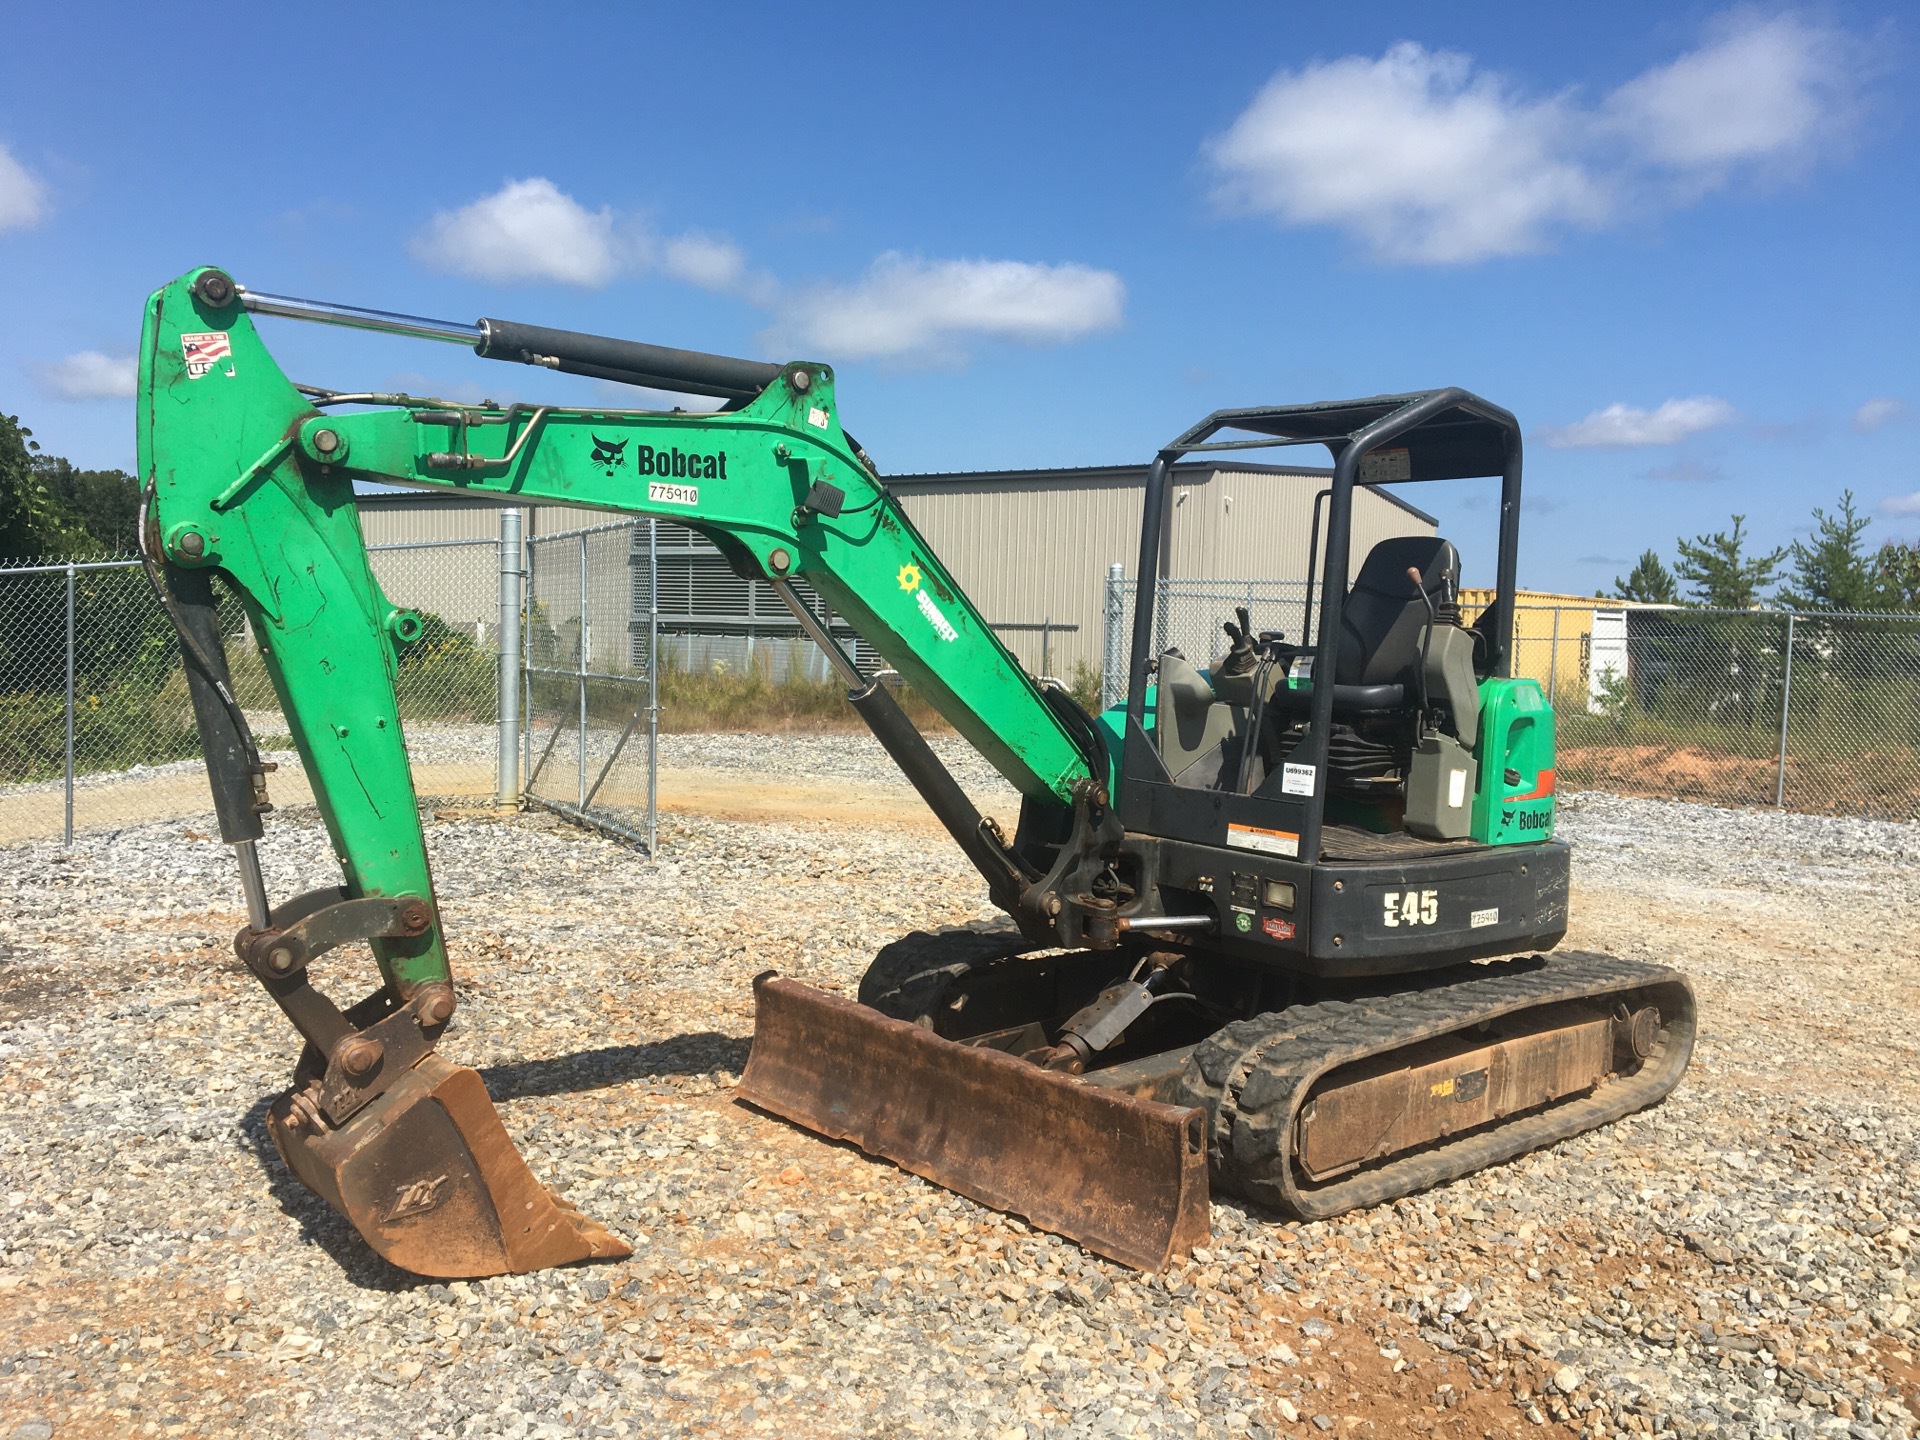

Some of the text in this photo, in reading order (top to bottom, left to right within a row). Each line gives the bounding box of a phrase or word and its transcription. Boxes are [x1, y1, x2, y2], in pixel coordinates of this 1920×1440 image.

[638, 444, 727, 480] Bobcat
[650, 485, 697, 502] 775910
[916, 589, 959, 643] SUNBELT
[1383, 889, 1438, 927] E45
